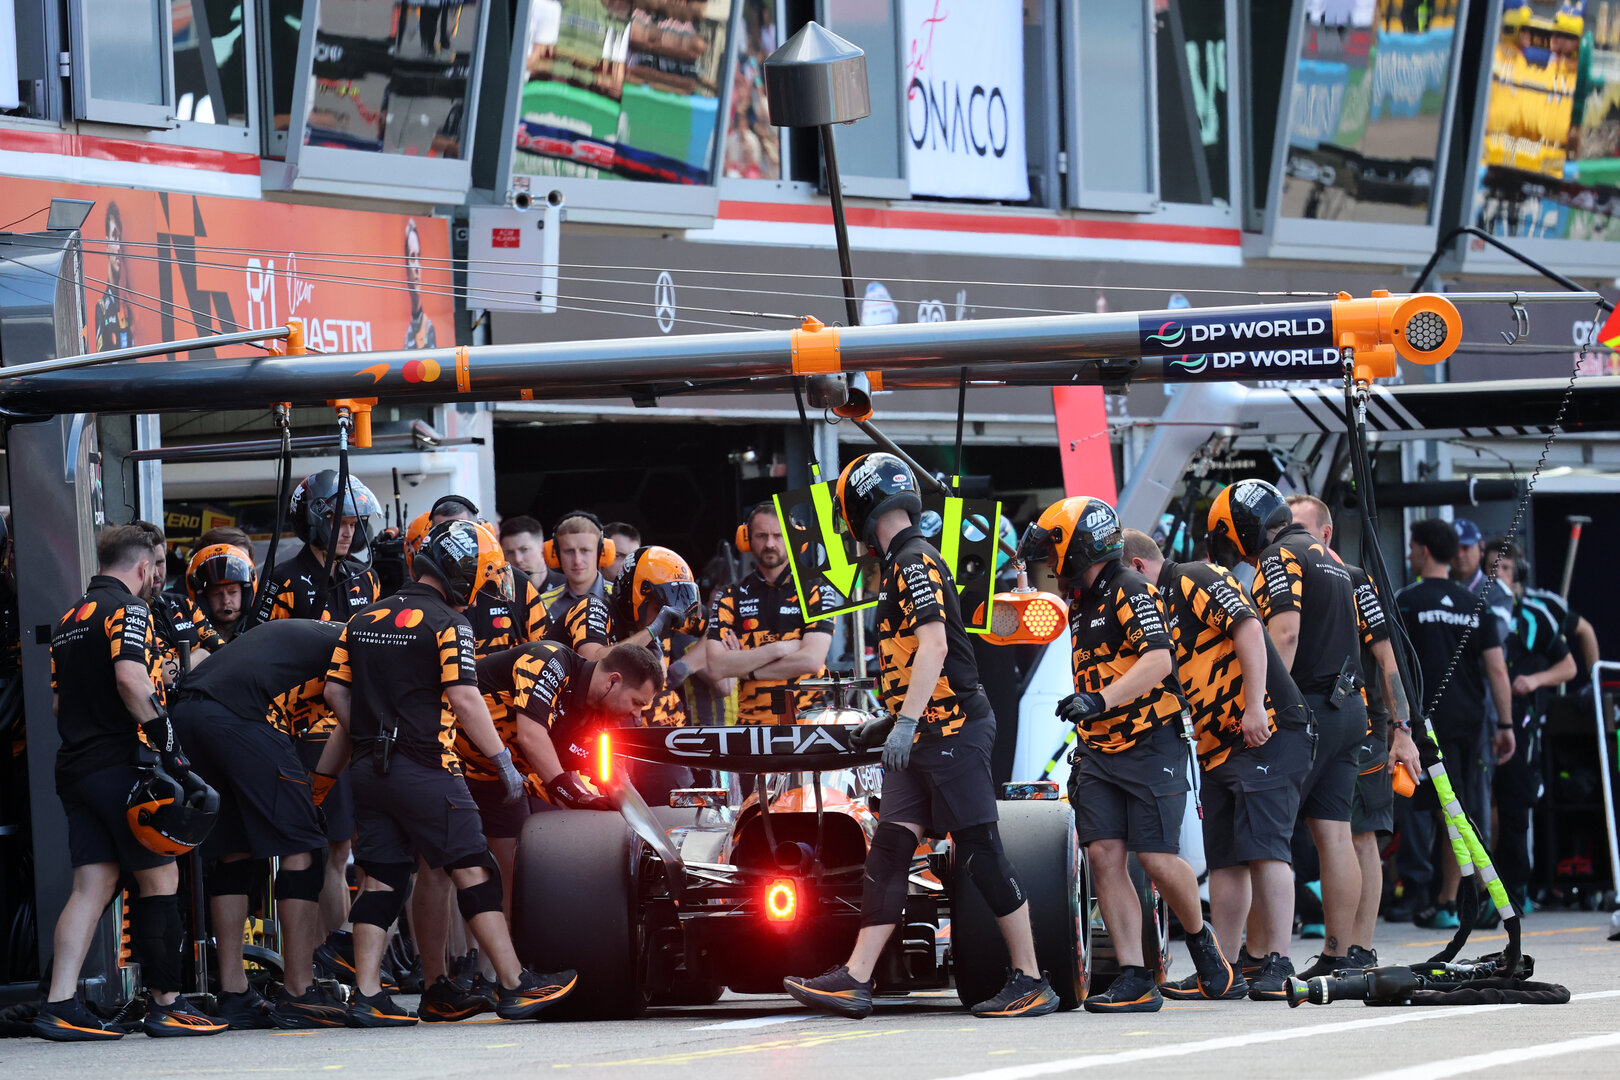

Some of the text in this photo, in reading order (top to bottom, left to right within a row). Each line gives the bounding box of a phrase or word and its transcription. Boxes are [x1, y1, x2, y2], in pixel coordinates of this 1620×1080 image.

[286, 252, 315, 315] Oscar
[288, 316, 373, 354] IASTRI
[1191, 317, 1325, 342] DP WORLD
[1213, 348, 1340, 369] DP WORLD
[1086, 508, 1108, 528] ON
[903, 564, 924, 575] FxPro
[1207, 580, 1225, 592] FxPro
[1130, 593, 1151, 604] FxPro
[739, 605, 759, 614] DELL
[125, 616, 146, 627] okta
[1090, 617, 1106, 628] OKX
[352, 630, 379, 638] McLAREN
[541, 670, 559, 689] okta
